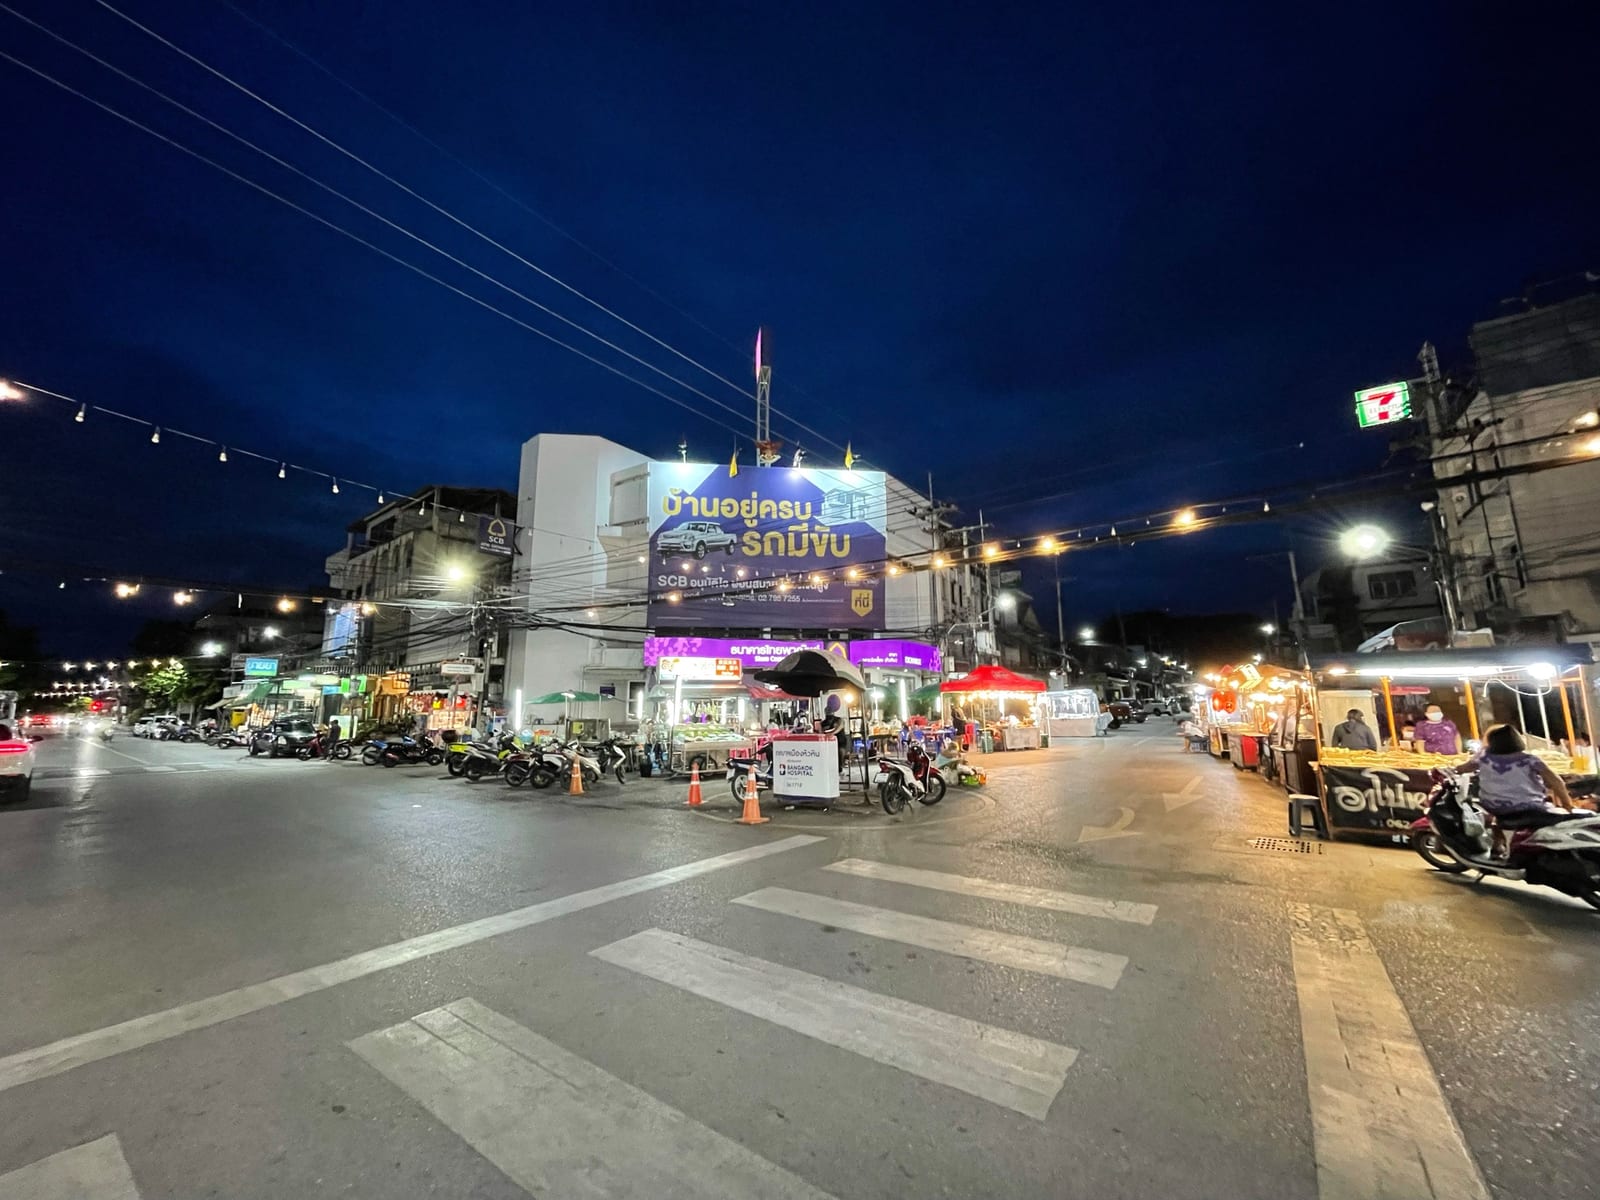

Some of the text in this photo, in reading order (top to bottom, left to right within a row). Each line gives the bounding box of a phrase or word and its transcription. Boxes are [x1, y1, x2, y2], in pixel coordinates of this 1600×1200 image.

[1367, 390, 1395, 420] 7
[662, 487, 812, 528] บ้านอยู่ครบ
[488, 536, 505, 545] SCB
[657, 575, 688, 587] SCB
